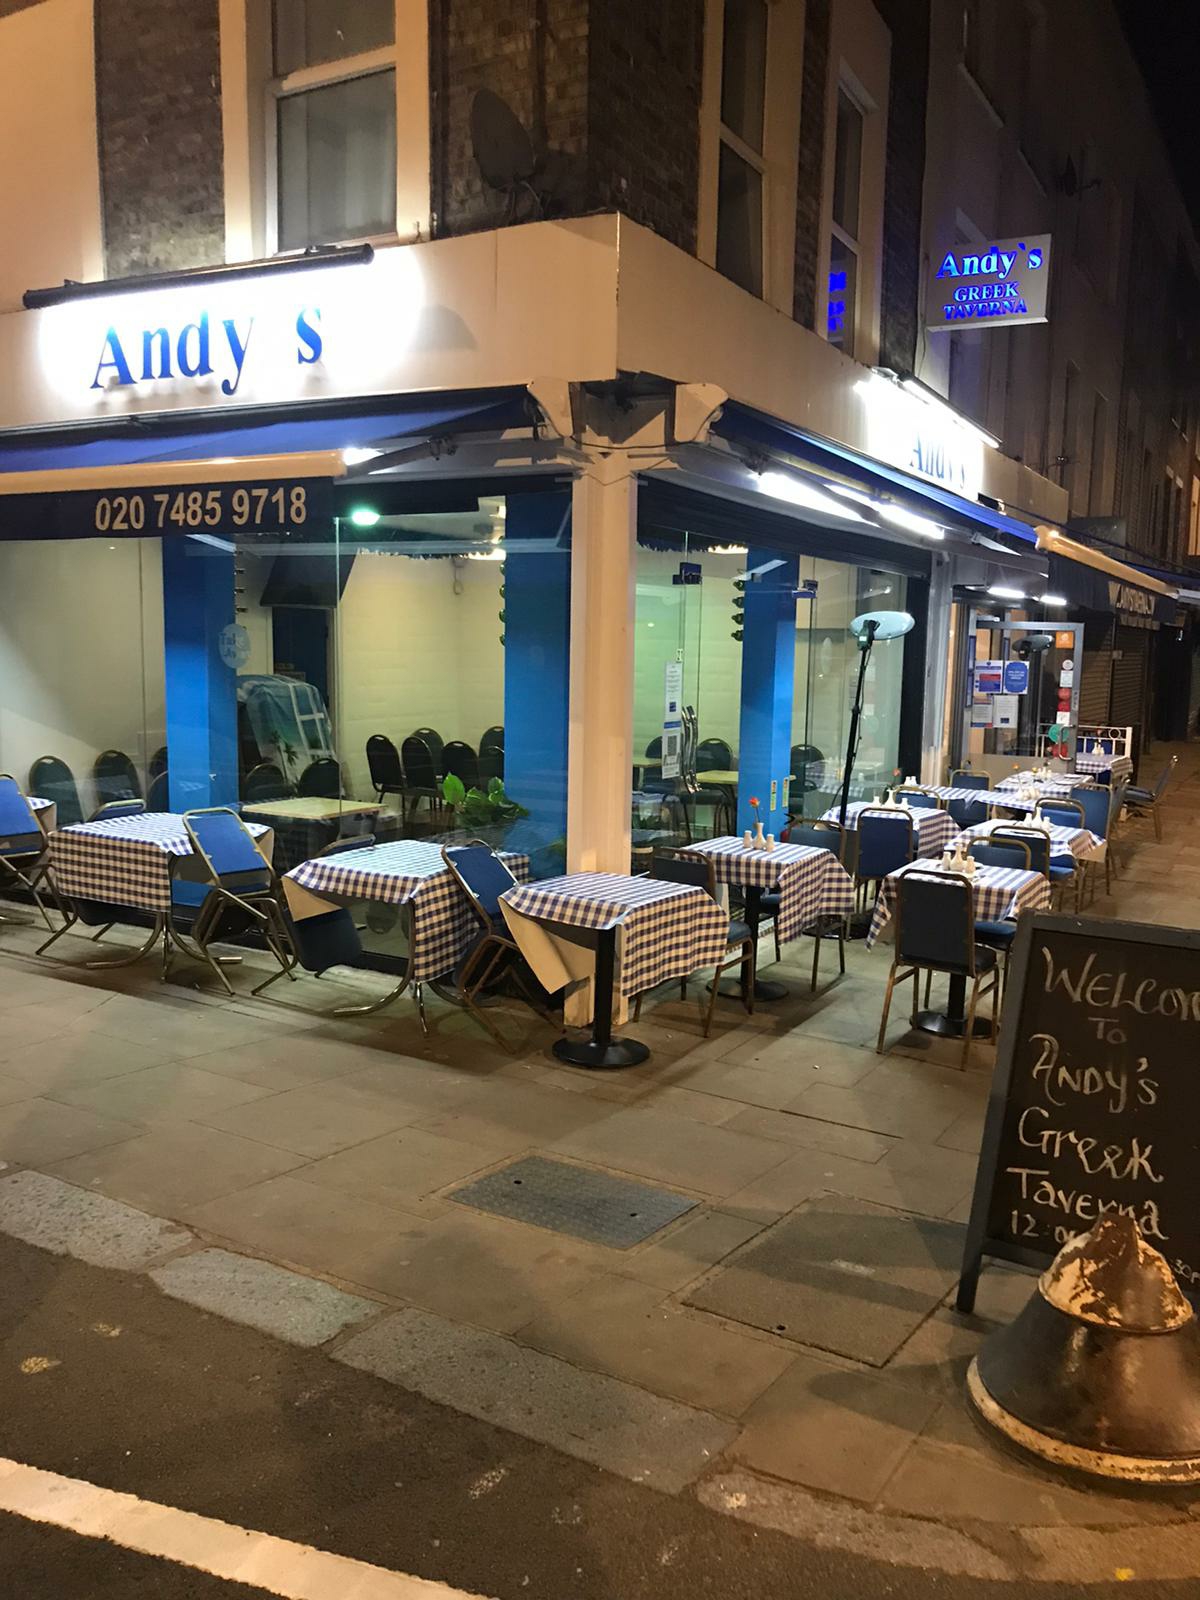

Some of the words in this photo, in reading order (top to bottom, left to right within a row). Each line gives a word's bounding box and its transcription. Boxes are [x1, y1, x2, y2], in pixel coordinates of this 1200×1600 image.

[954, 281, 1019, 302] GREEK
[943, 300, 1027, 320] TAVERNA
[95, 495, 145, 531] 020
[154, 490, 222, 528] 7485
[231, 486, 307, 526] 9718
[1018, 1106, 1165, 1183] Greek
